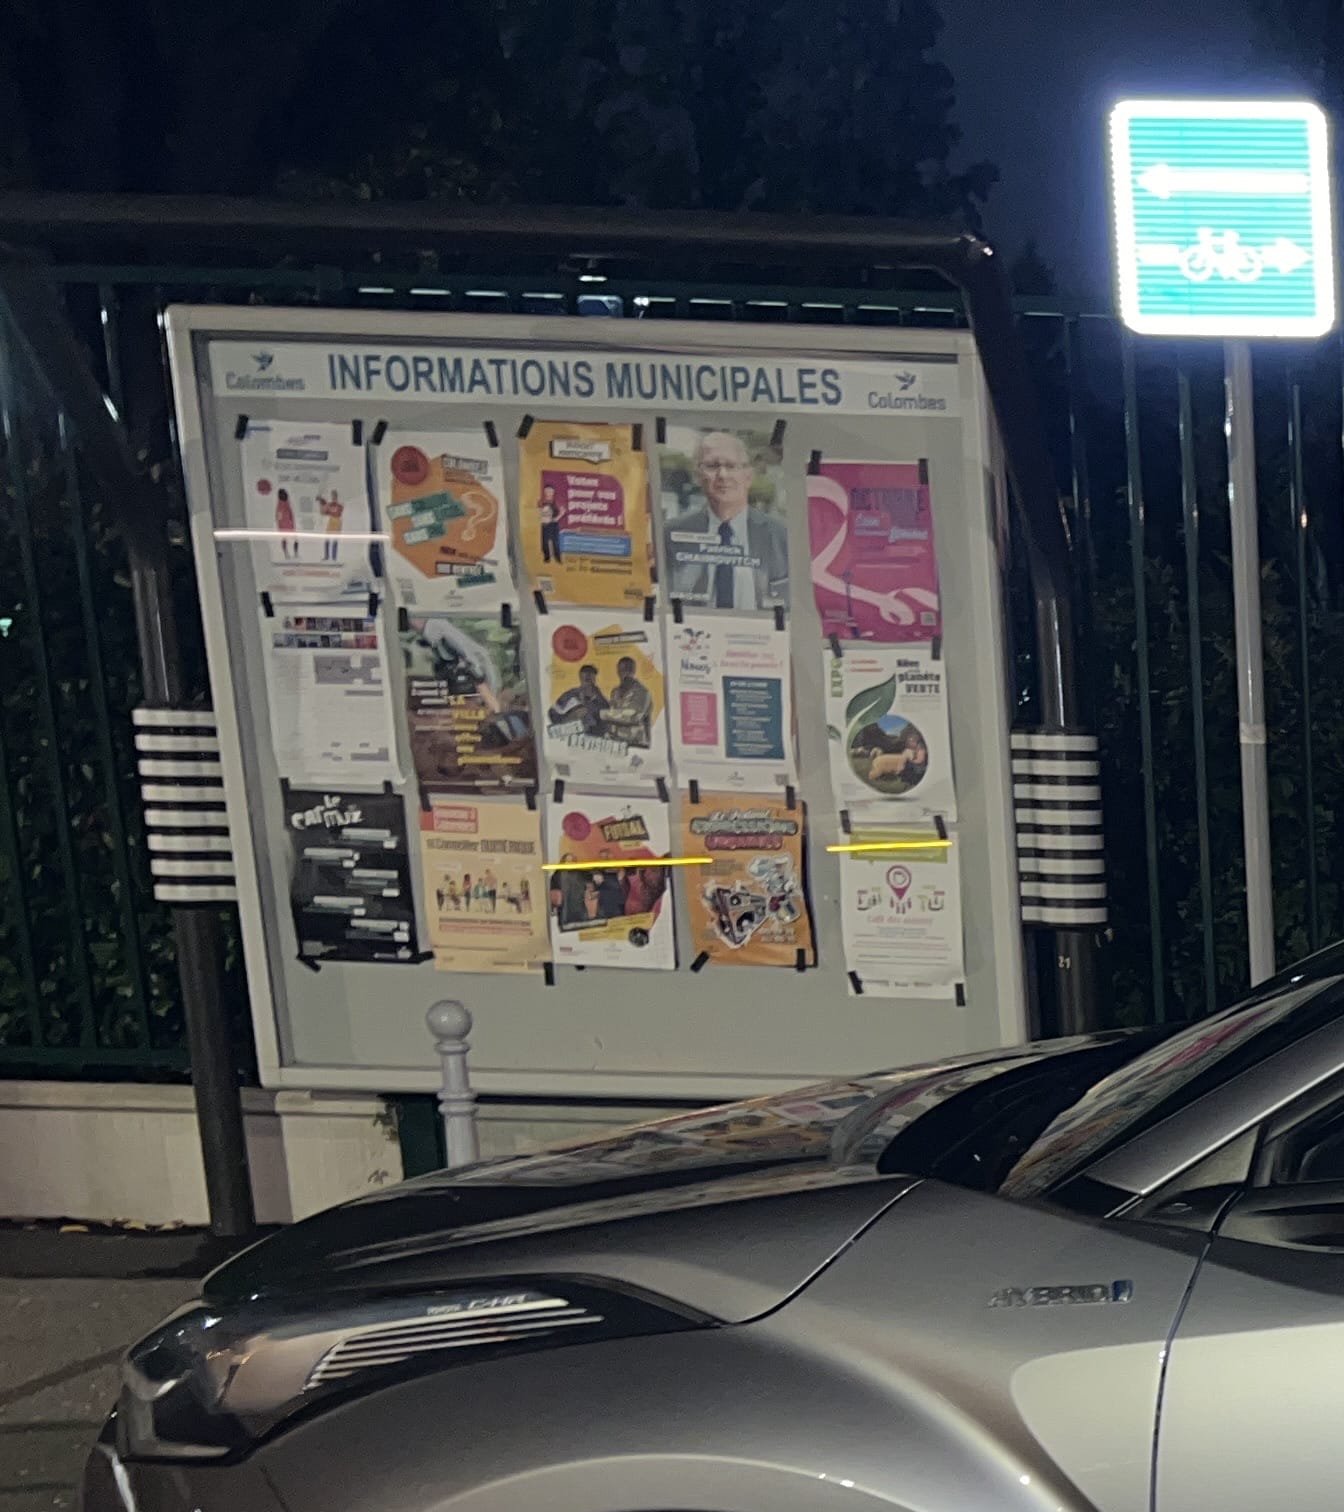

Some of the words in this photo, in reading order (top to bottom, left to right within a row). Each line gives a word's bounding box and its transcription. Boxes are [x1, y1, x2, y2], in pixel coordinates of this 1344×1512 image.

[327, 354, 595, 398] INFORMATIONS
[605, 361, 843, 406] MUNICIPALES
[867, 390, 947, 411] Colombes
